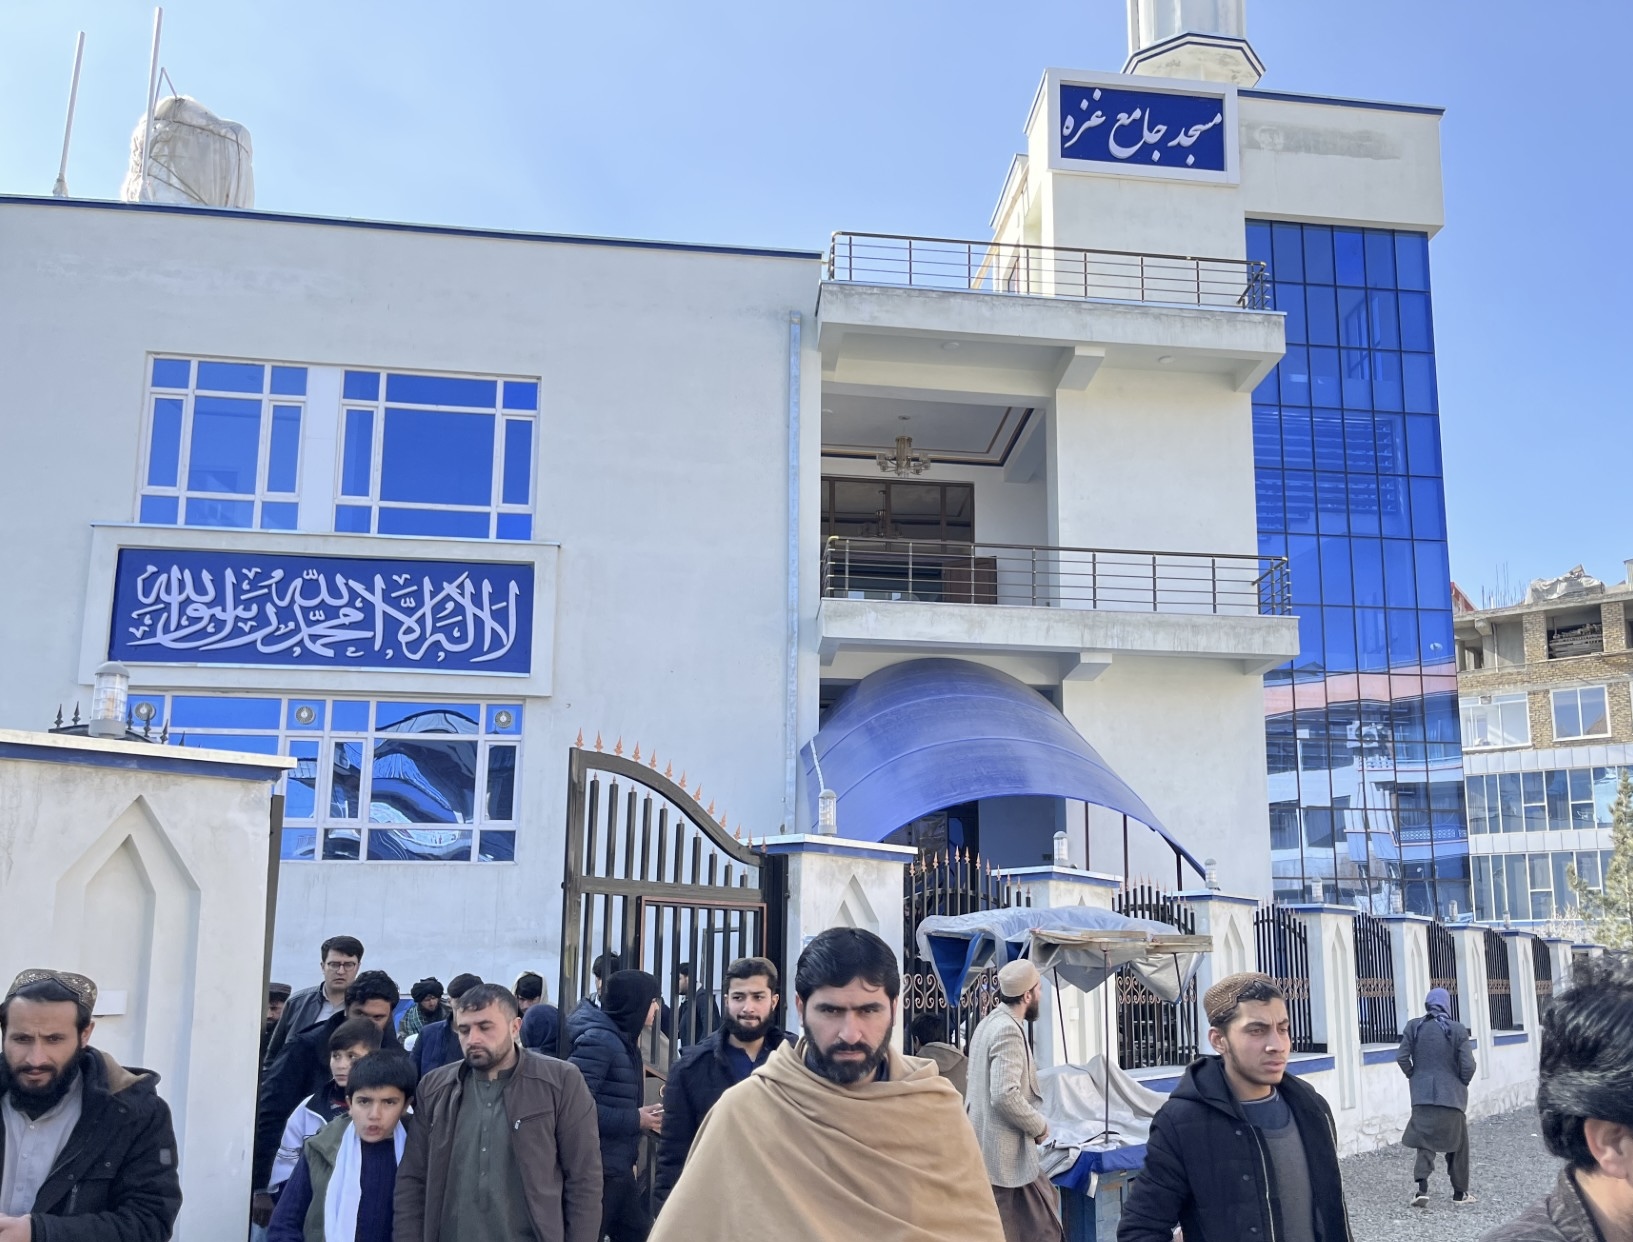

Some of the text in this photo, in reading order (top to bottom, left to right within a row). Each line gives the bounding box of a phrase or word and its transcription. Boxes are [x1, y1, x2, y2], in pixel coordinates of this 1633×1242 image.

[1108, 107, 1168, 162] جامع
[1167, 112, 1223, 166] مسجد
[125, 566, 280, 652] رسول
[256, 602, 375, 659] محمد
